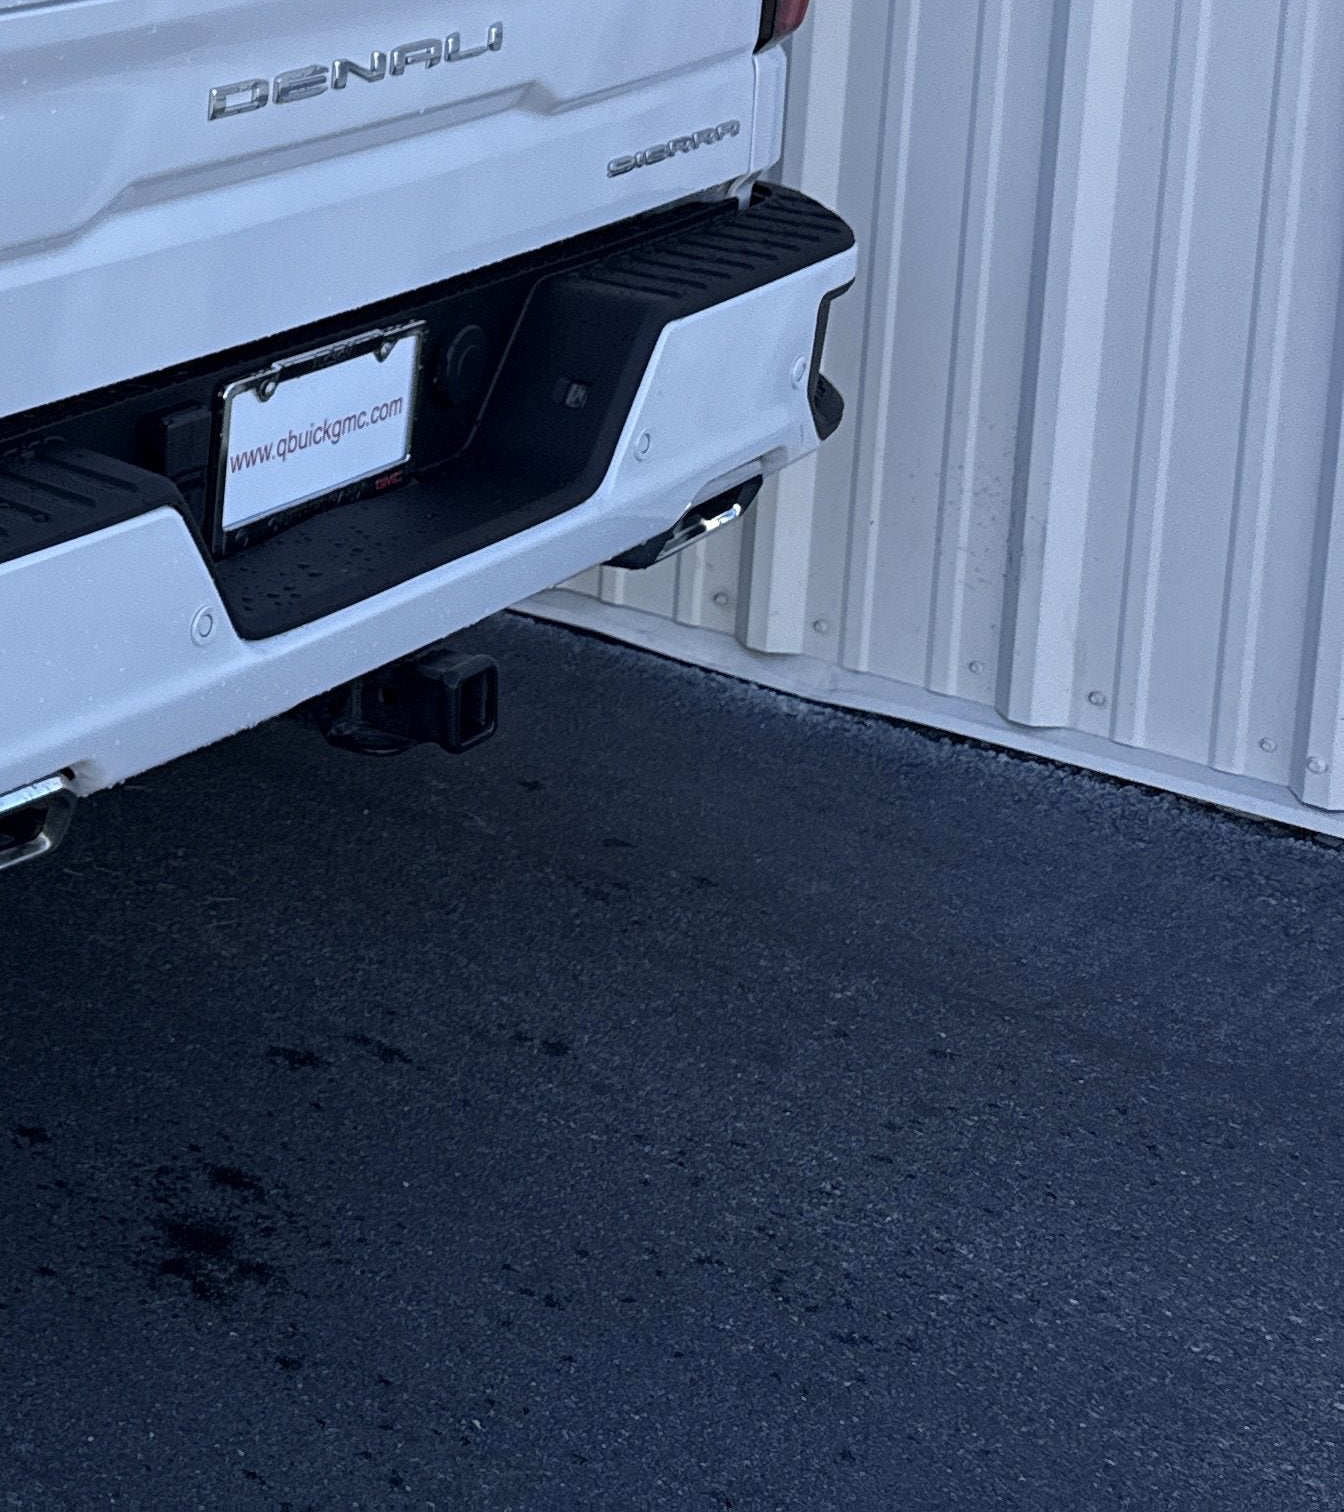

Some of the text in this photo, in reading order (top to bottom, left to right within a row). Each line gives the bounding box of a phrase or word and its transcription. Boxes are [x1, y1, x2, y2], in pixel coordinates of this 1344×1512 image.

[208, 21, 503, 121] DENALI
[607, 120, 740, 178] SIERRA
[230, 396, 404, 473] www.qbuickgmc.com
[375, 470, 404, 490] GMC
